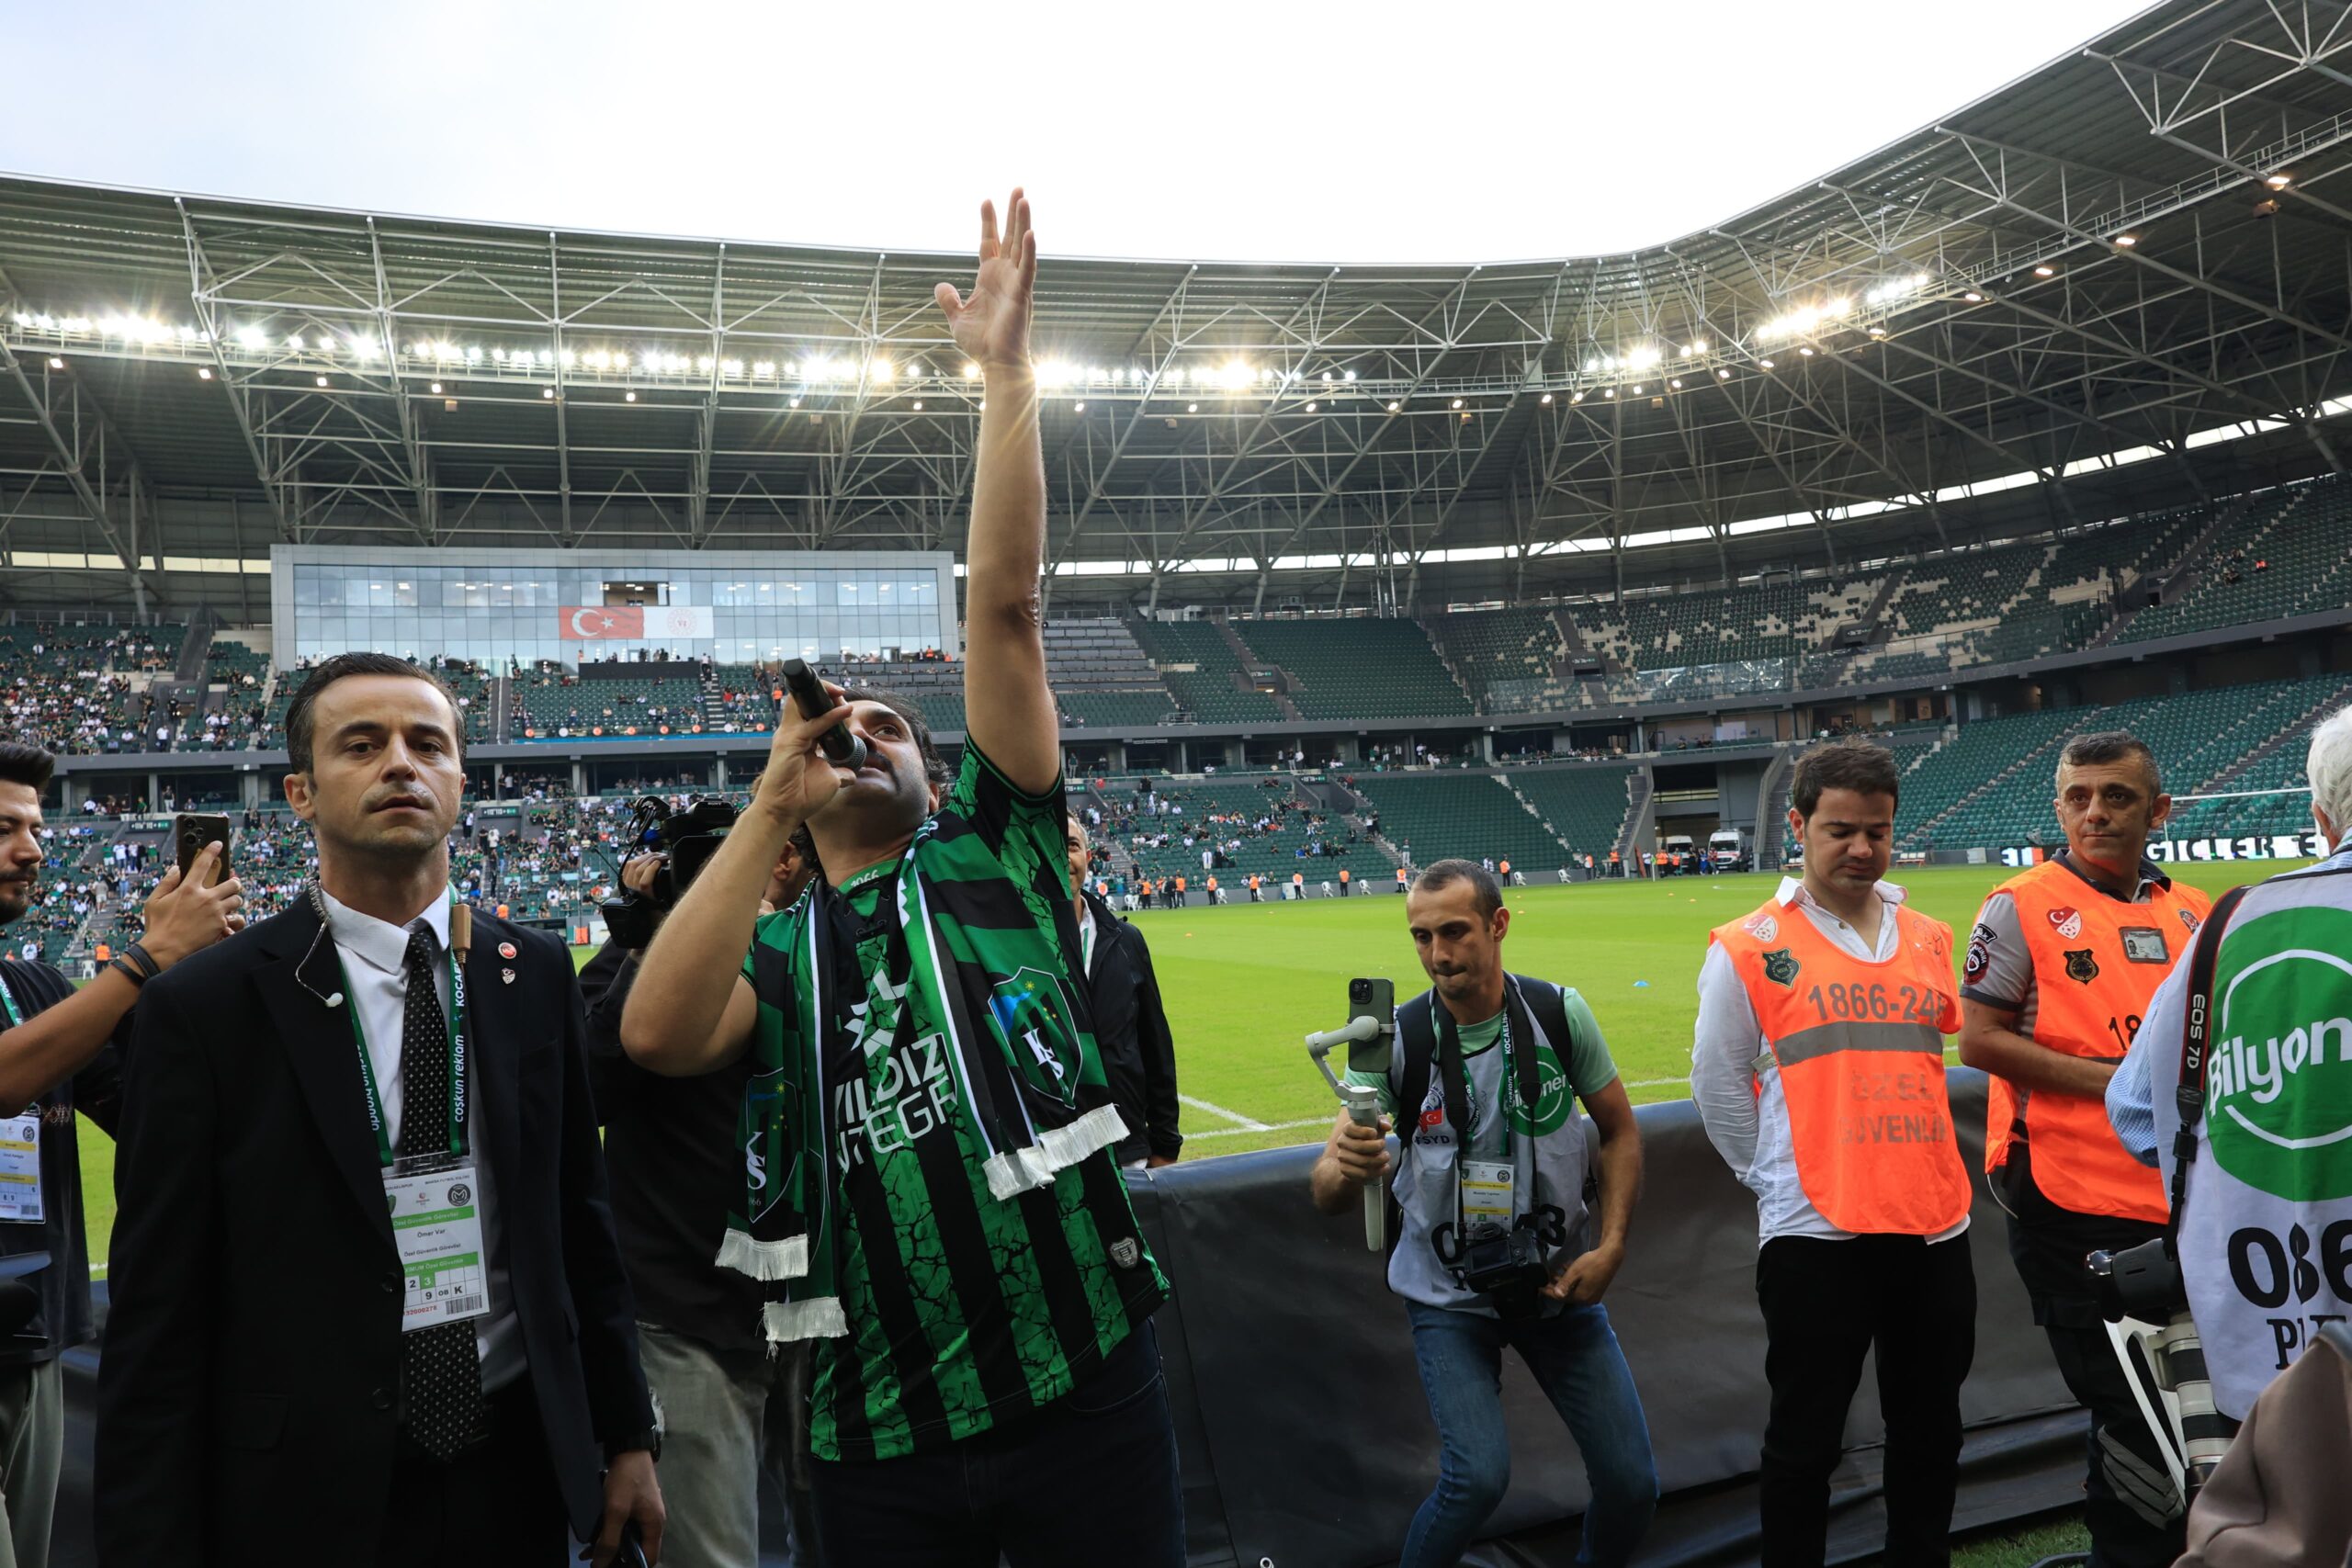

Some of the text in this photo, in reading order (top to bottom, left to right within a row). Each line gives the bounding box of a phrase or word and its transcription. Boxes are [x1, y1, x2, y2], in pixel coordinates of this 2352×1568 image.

[2187, 994, 2206, 1069] EOS 7D
[454, 1034, 465, 1123] coşkun reklam
[410, 1277, 431, 1288] 2 3
[425, 1292, 433, 1300] 9
[454, 1286, 463, 1294] K
